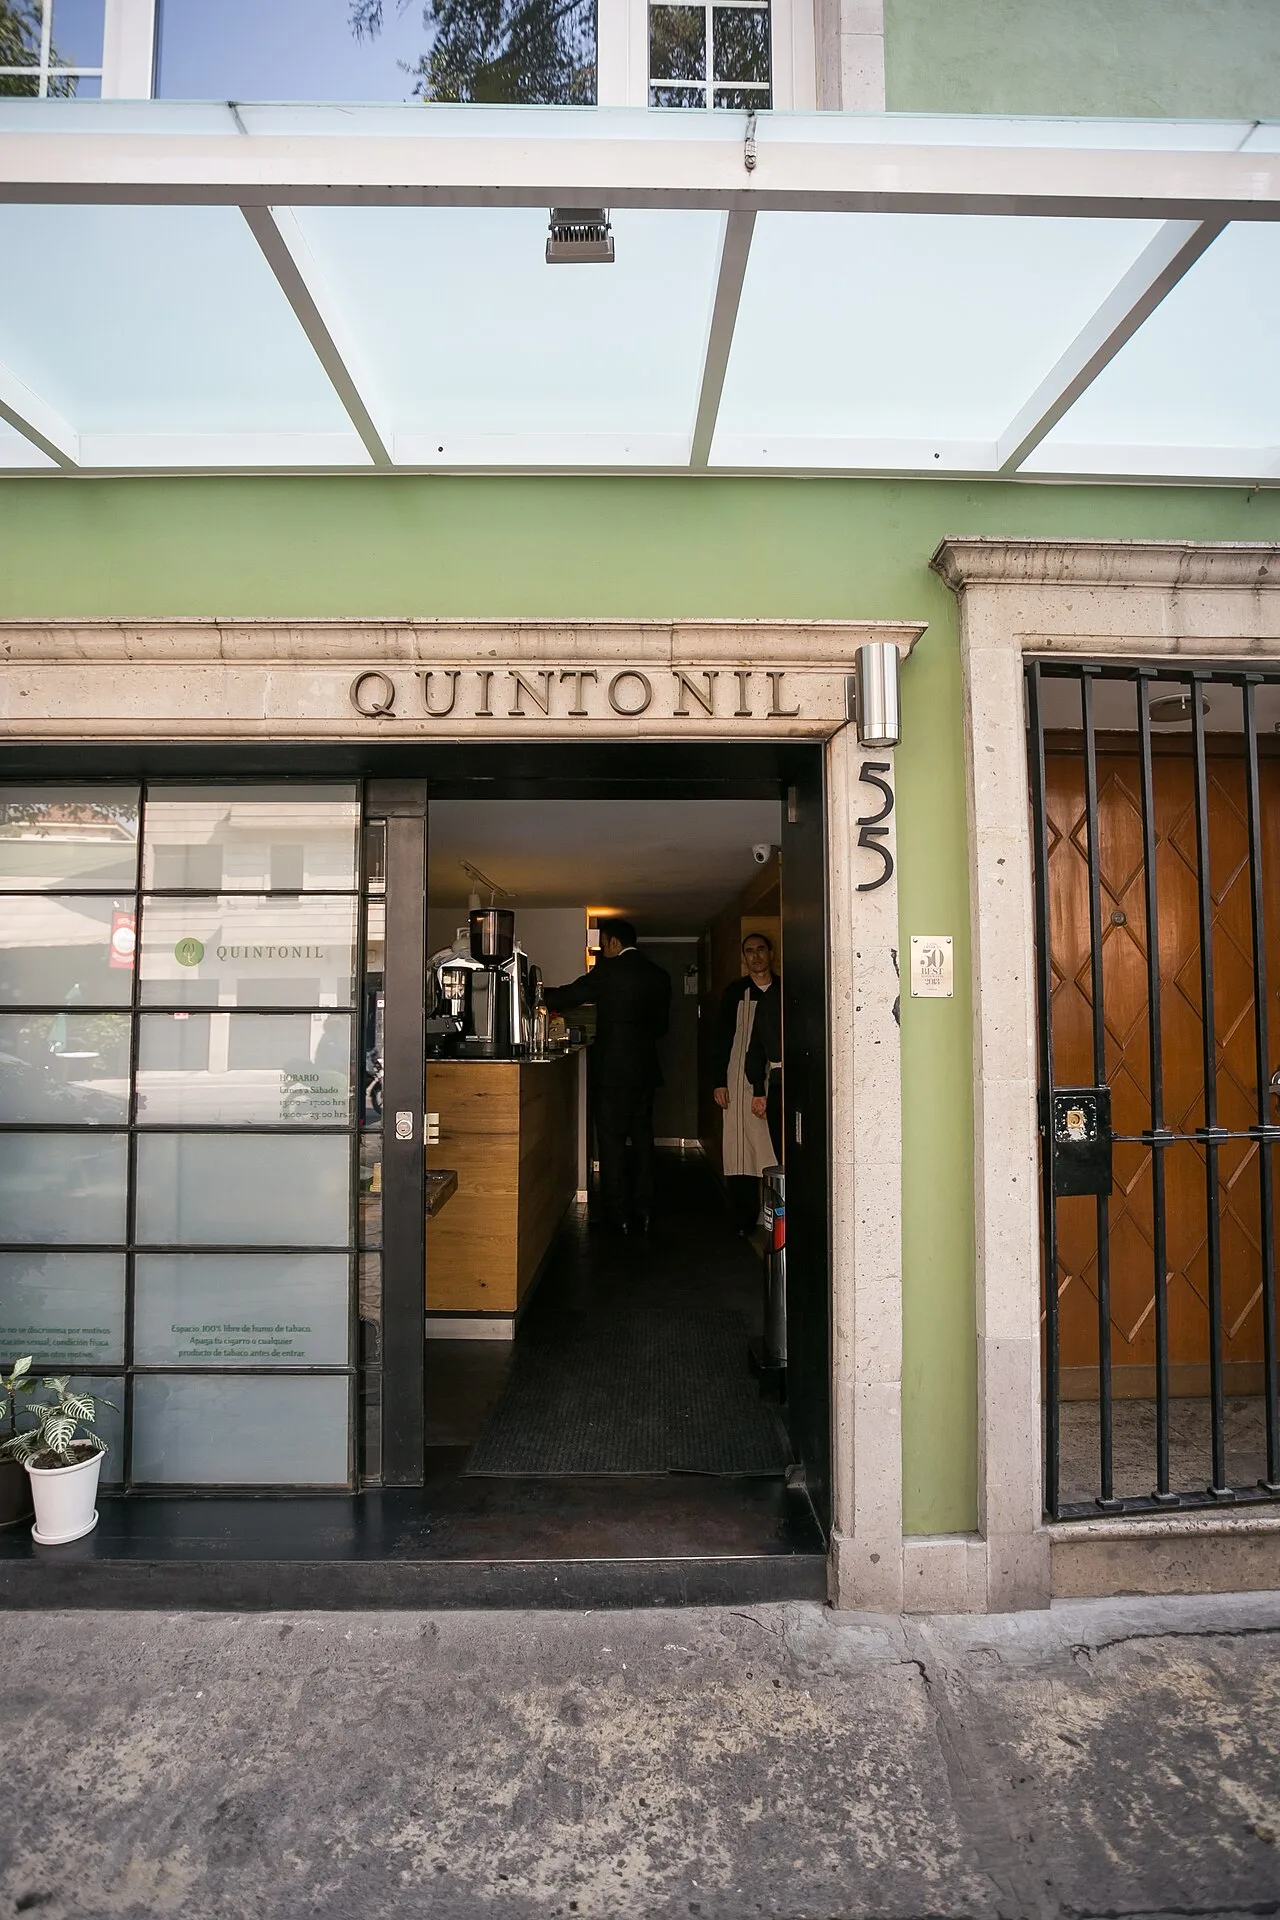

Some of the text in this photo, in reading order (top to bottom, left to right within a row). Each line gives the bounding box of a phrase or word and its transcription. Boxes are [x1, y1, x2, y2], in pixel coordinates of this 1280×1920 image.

[349, 669, 800, 718] QUINTONIL
[216, 946, 324, 961] QUINTONIL
[920, 949, 944, 968] 50
[279, 1073, 319, 1082] HORARIO
[279, 1086, 303, 1094] Lunes
[310, 1085, 339, 1094] Sábado
[309, 1100, 331, 1108] 17:00
[332, 1098, 346, 1106] hrs
[334, 1110, 348, 1118] hrs
[67, 1327, 81, 1336] por
[171, 1324, 200, 1334] Espacio
[223, 1324, 240, 1333] libre
[241, 1324, 250, 1332] de
[252, 1324, 274, 1332] humo
[275, 1324, 284, 1332] de
[189, 1337, 213, 1346] Apaga
[224, 1337, 251, 1346] cigarro
[257, 1337, 293, 1346] cualquier
[178, 1348, 212, 1358] producto
[212, 1348, 222, 1357] de
[223, 1348, 249, 1357] tabaco
[271, 1348, 280, 1357] de
